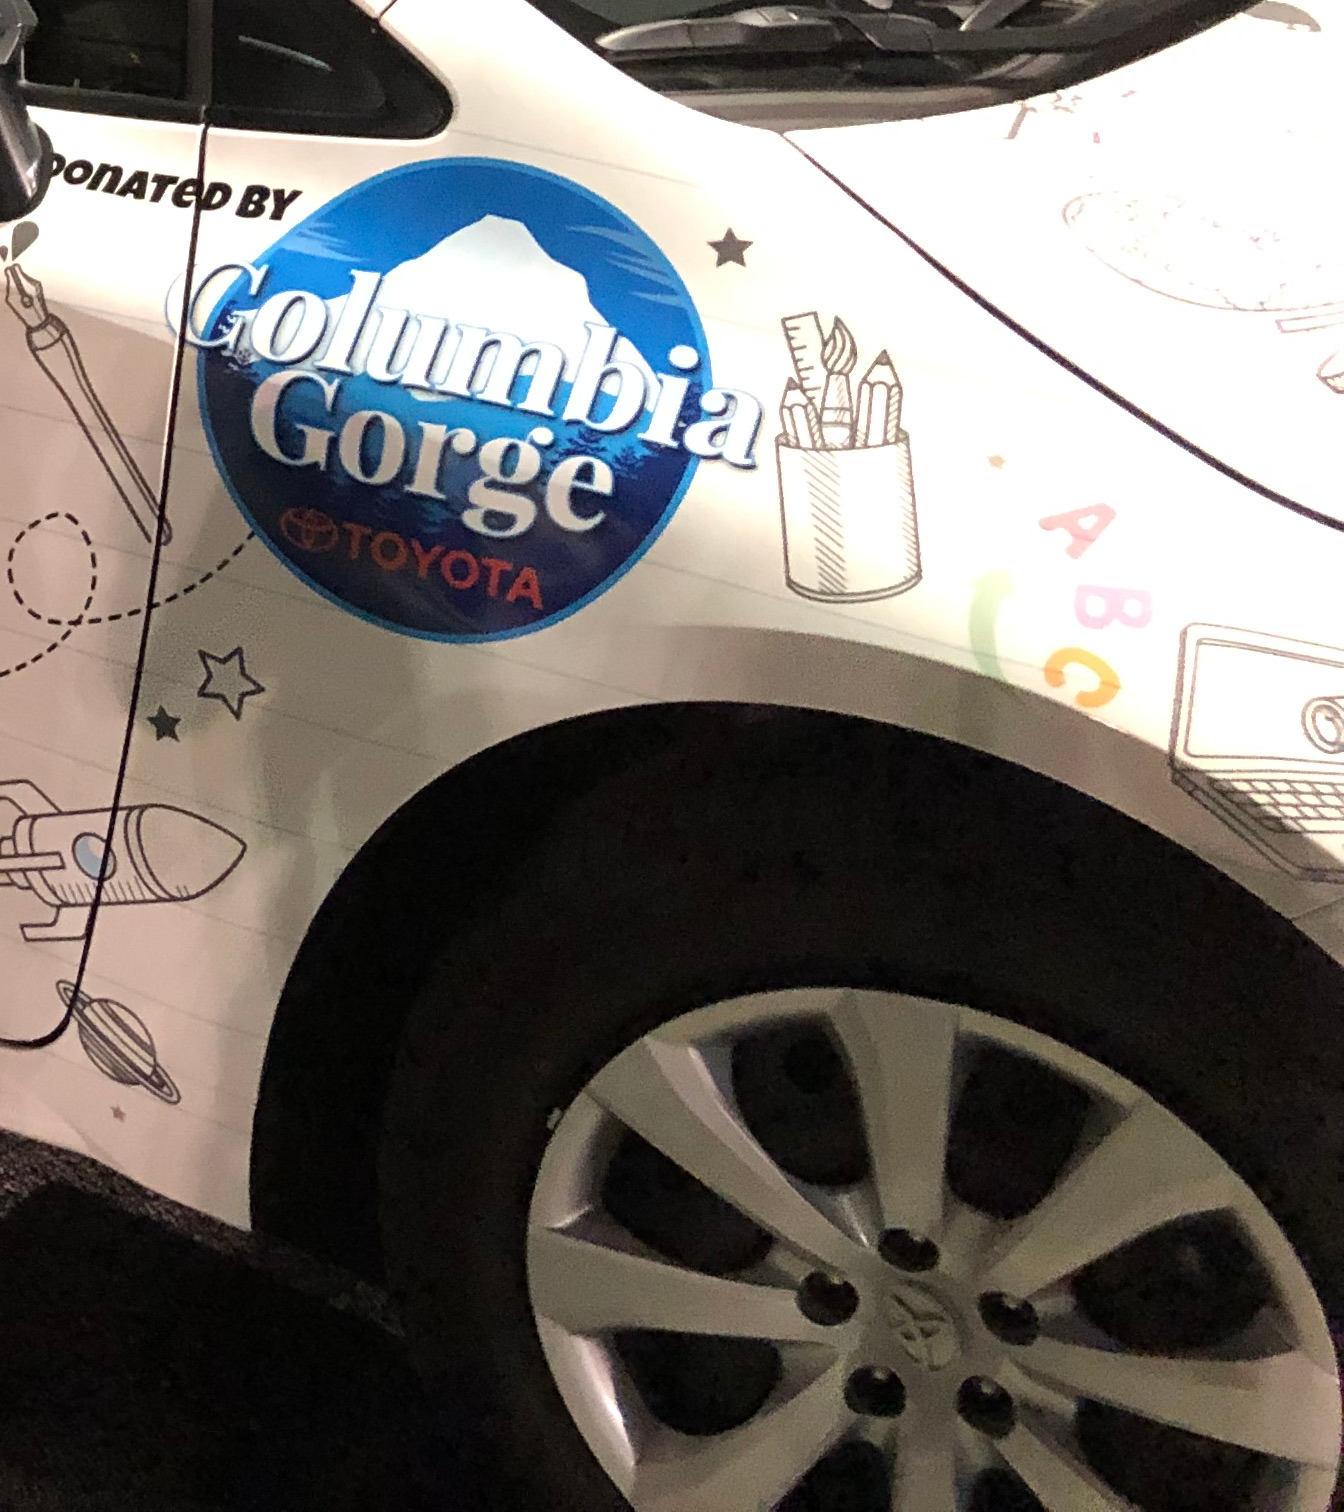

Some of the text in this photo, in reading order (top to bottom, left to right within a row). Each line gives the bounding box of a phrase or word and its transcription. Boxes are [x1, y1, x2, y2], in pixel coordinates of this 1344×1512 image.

[235, 184, 303, 221] BY
[165, 260, 765, 470] Columbia
[249, 370, 613, 538] Gorge
[346, 521, 544, 611] TOYOTA
